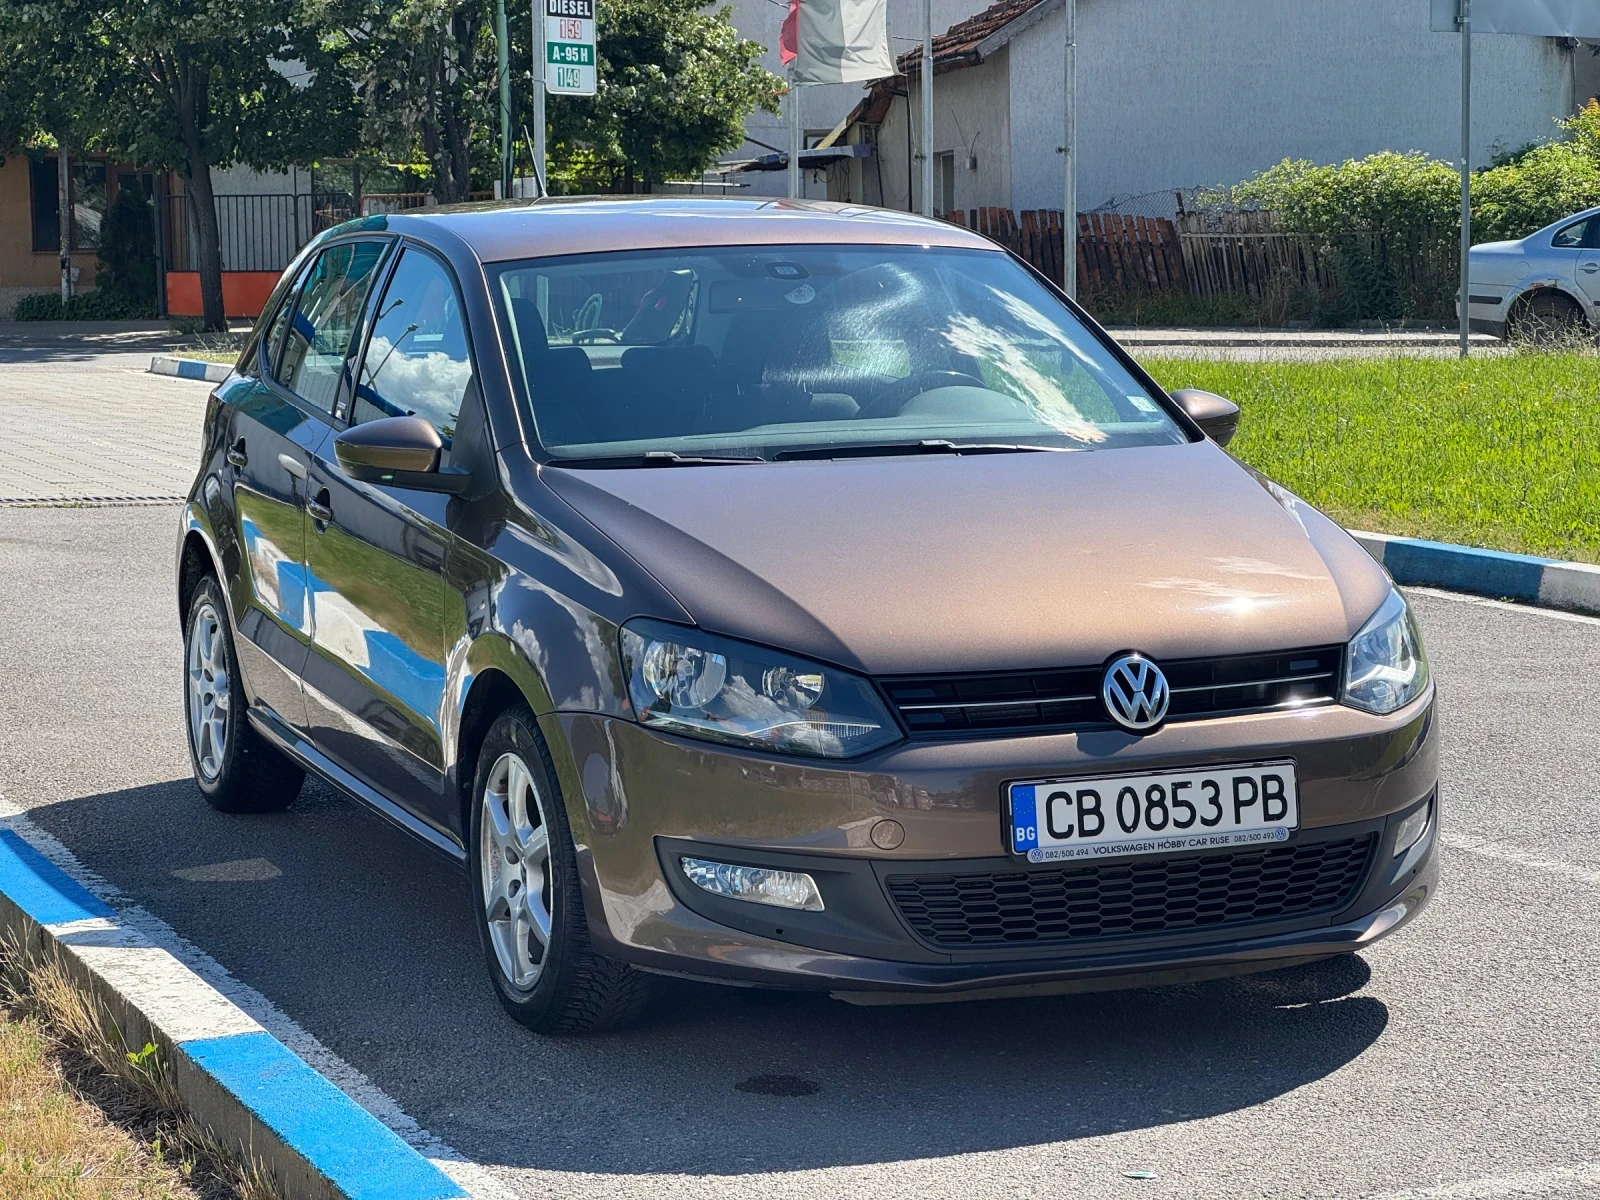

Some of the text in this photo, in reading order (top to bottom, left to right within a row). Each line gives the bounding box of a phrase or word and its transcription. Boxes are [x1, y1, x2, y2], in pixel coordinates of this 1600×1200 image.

[549, 0, 591, 16] DIESEL
[552, 45, 588, 62] A-95 H
[1045, 774, 1288, 839] CB 0853 PB
[1016, 826, 1036, 842] BG
[1045, 851, 1074, 859] 082/500
[1075, 848, 1089, 856] 494
[1093, 843, 1155, 855] VOLKSWAGEN
[1157, 838, 1187, 851] HOBBY
[1188, 837, 1208, 848] CAR
[1209, 835, 1230, 846] RUSE
[1233, 834, 1261, 843] 082/500
[1262, 832, 1275, 840] 493
